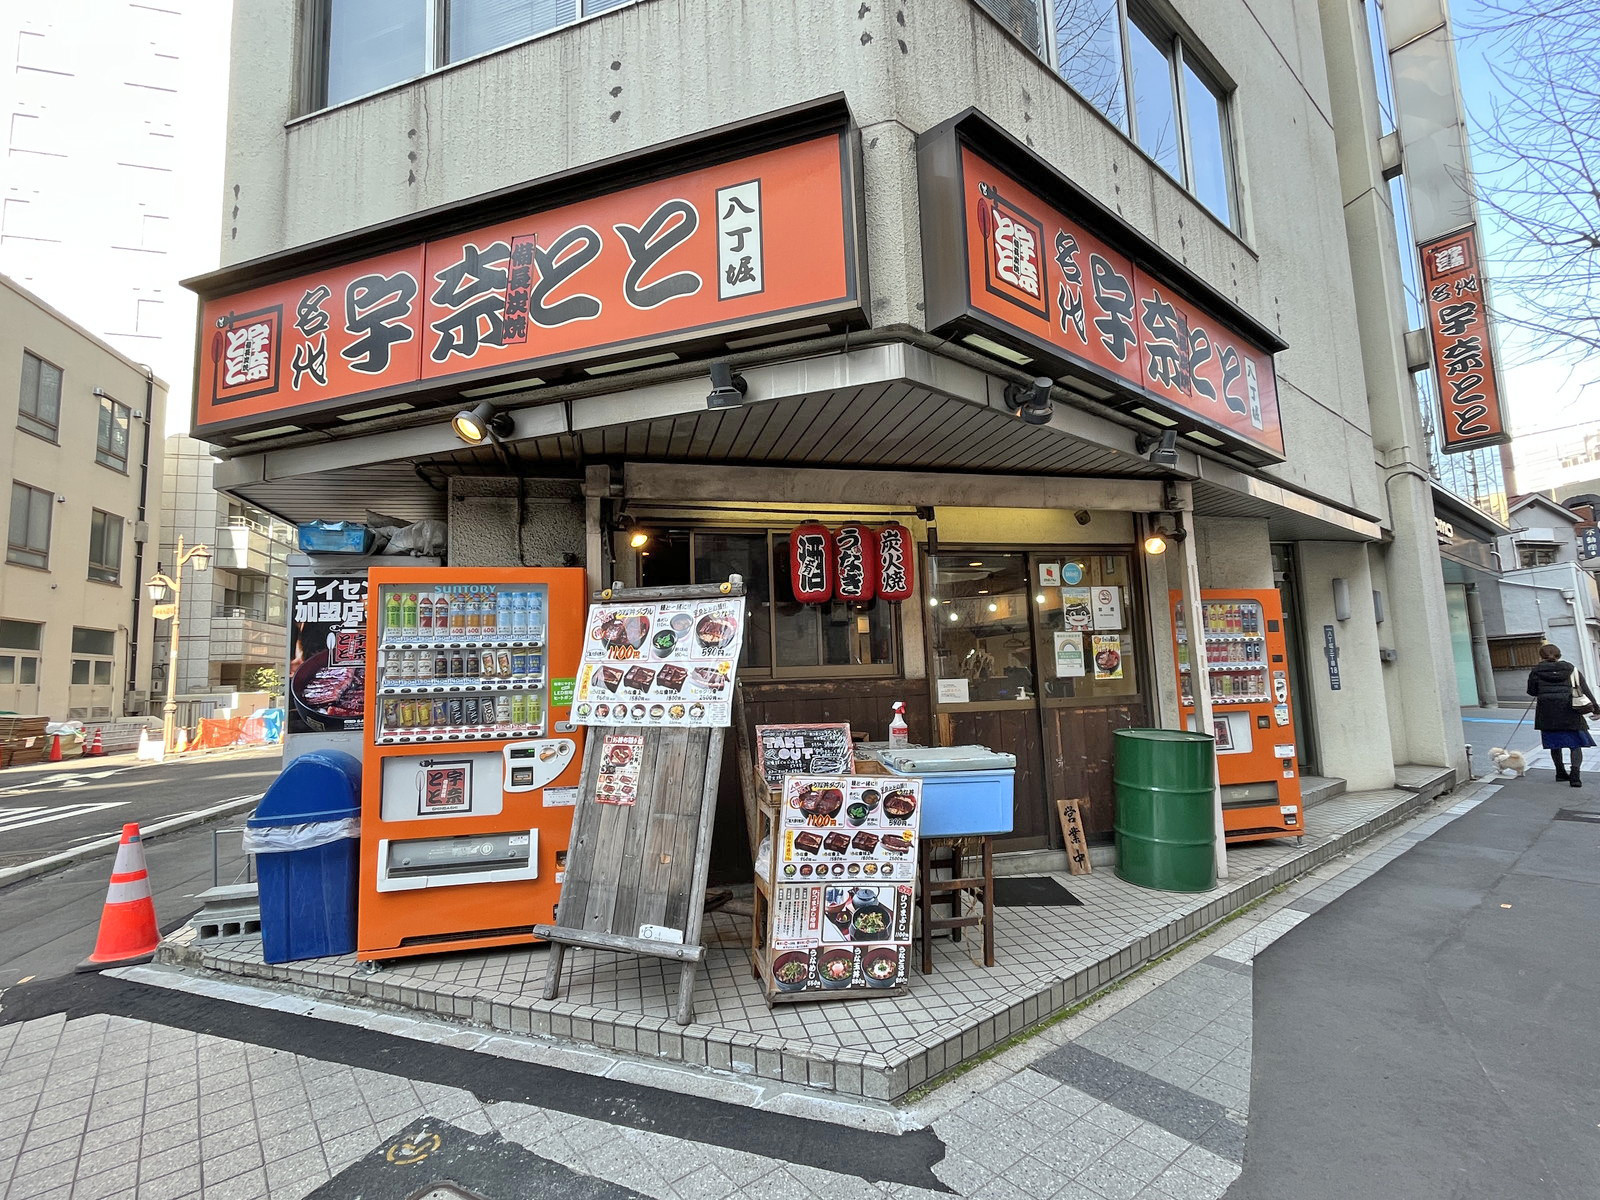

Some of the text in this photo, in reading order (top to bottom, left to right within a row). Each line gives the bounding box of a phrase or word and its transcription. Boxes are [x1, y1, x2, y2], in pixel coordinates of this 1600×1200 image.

[723, 196, 756, 286] 八丁堀
[503, 240, 535, 340] 備長炭焼
[1054, 228, 1088, 345] 名代
[1430, 274, 1479, 302] 名代
[291, 285, 332, 391] 名代
[1437, 301, 1490, 436] 宇奈とと
[837, 528, 863, 596] うなぎ
[880, 530, 907, 592] 炭火焼
[434, 585, 496, 594] SUNTORY
[294, 602, 368, 622] 加盟店
[608, 645, 641, 660] 1100円
[701, 647, 725, 657] 590円
[484, 703, 494, 723] BOSS
[763, 736, 805, 748] TAKE
[778, 748, 814, 760] OUT
[807, 814, 837, 827] 1100円
[1063, 805, 1085, 869] 営業中
